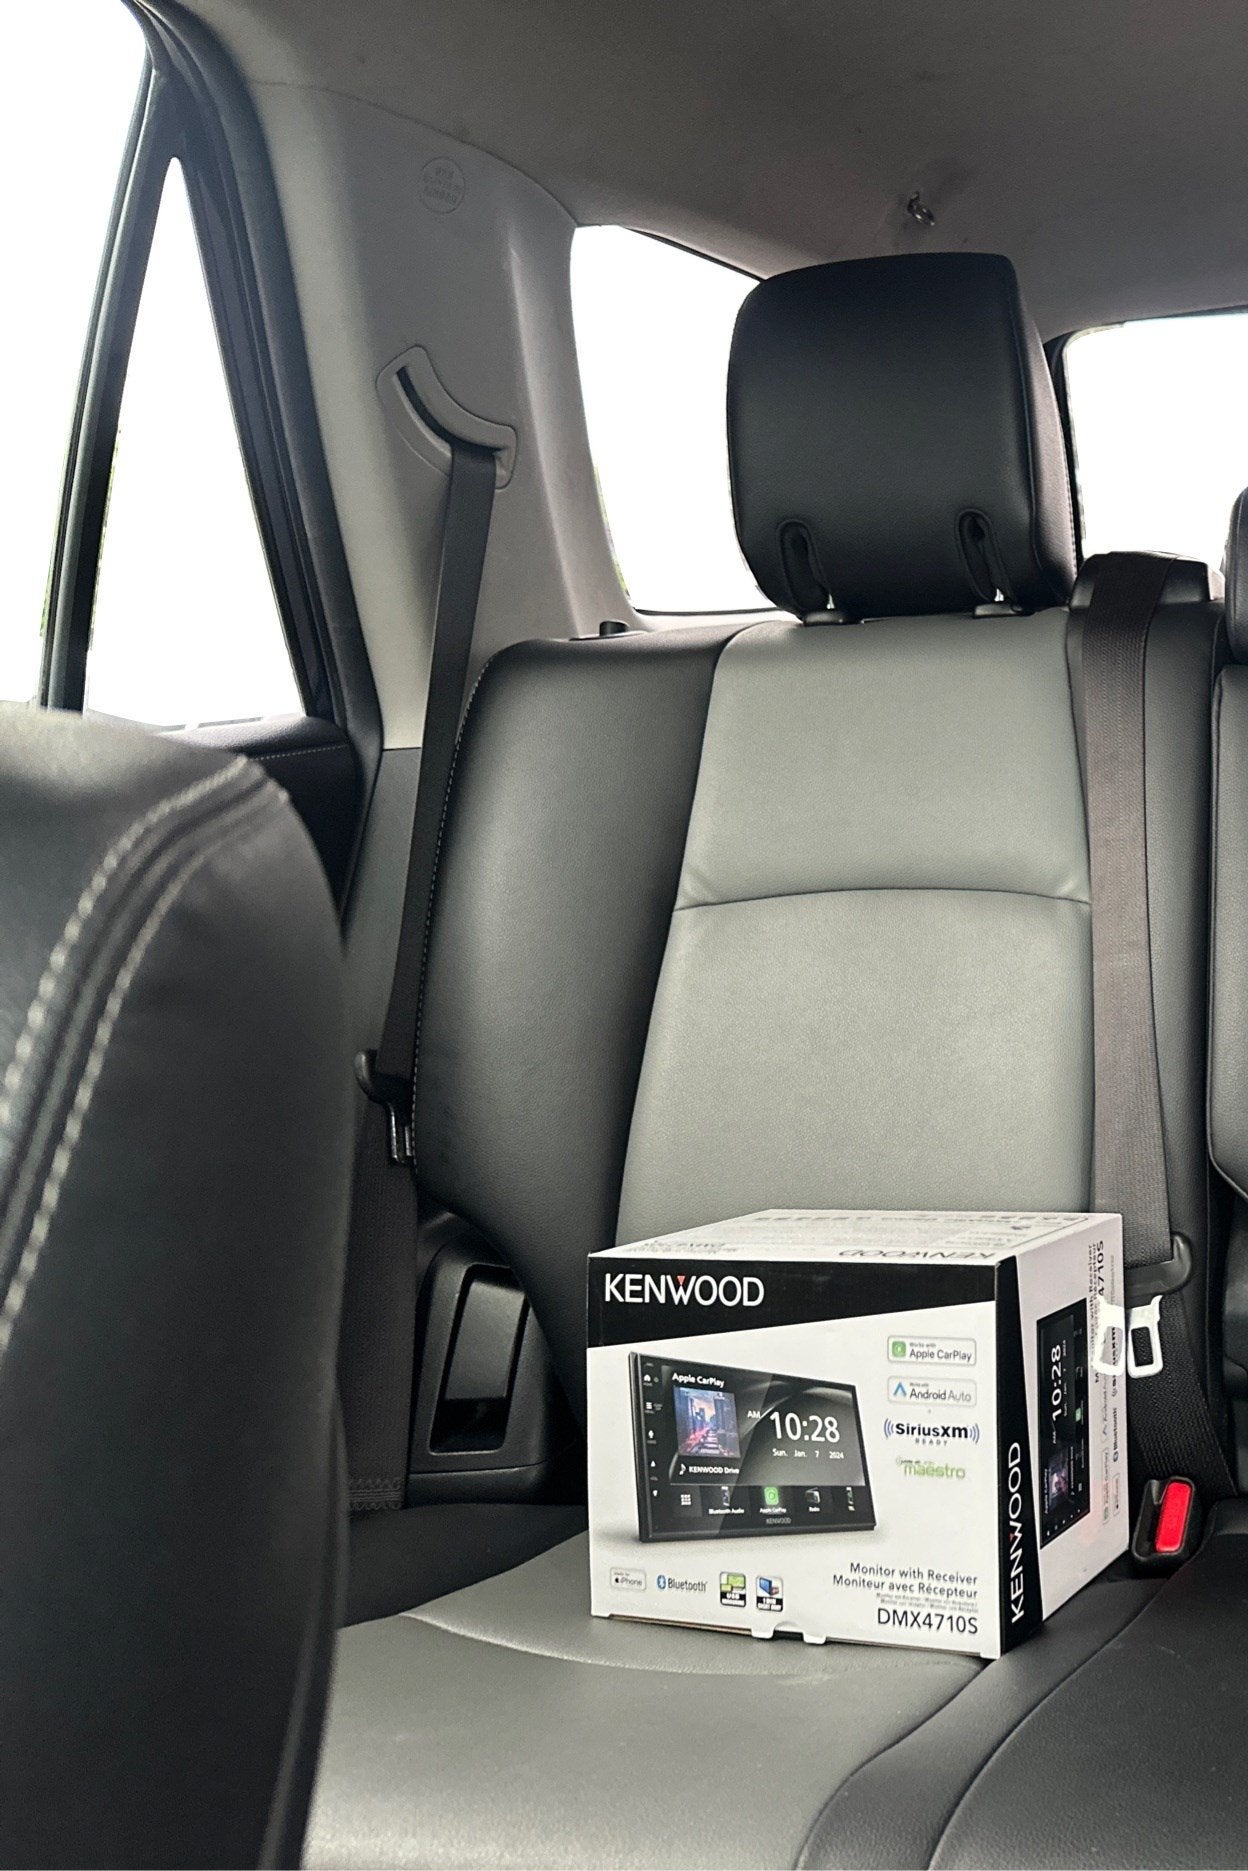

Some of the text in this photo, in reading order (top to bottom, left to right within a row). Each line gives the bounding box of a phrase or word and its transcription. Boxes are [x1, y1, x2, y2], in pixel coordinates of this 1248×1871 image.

[604, 1272, 765, 1307] KENWOOD
[909, 1349, 973, 1362] Apple CarPlay
[671, 1372, 725, 1389] Apple CarPlay
[1051, 1344, 1062, 1421] 10:28
[909, 1388, 973, 1403] Android Auto
[746, 1410, 760, 1419] AM
[769, 1411, 840, 1443] 10:28
[915, 1438, 948, 1446] READY
[772, 1448, 788, 1457] Sun.
[688, 1465, 724, 1474] KENWOOD
[1008, 1442, 1025, 1624] KENWOOD
[849, 1562, 979, 1585] Monitor with Receiver
[667, 1577, 707, 1592] Bluetooth
[832, 1574, 979, 1599] Moniteur avec Récepteur
[877, 1607, 979, 1635] DMX4710S
